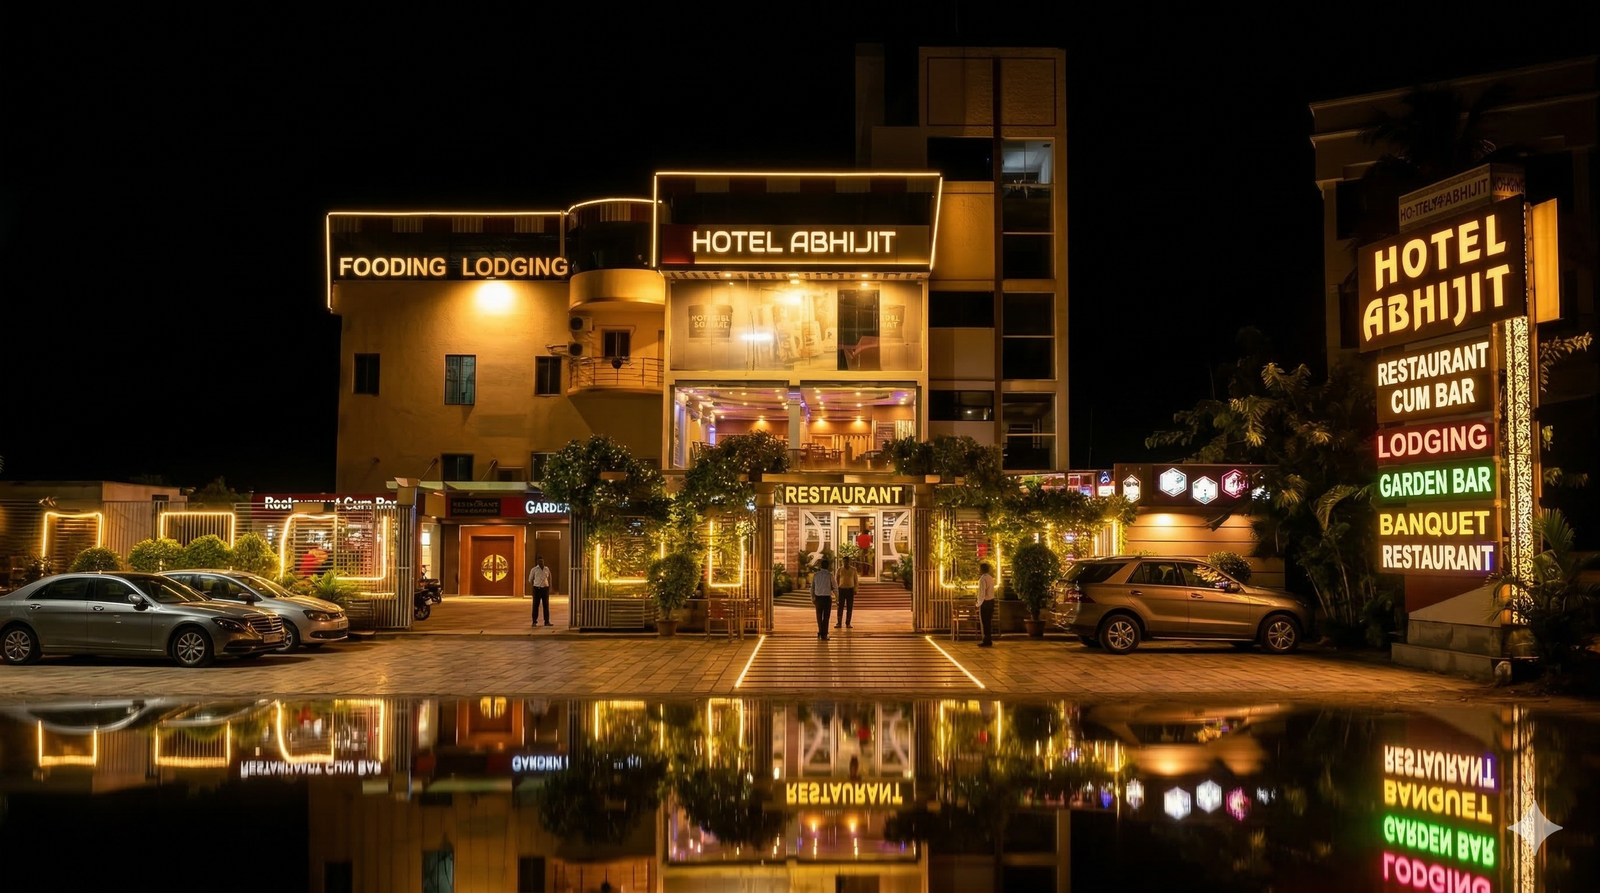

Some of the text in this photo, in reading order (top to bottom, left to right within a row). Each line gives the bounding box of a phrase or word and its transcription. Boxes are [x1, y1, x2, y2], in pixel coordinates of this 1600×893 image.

[692, 231, 897, 253] HOTEL ABHIJIT
[1374, 214, 1506, 292] HOTEL
[339, 257, 568, 276] FOODING LODGING
[1363, 264, 1510, 342] ABHIJIT
[1378, 341, 1489, 386] RESTAURANT
[1391, 378, 1475, 414] CUM BAR
[1378, 423, 1487, 459] LODGING
[785, 485, 904, 505] RESTAURANT
[1379, 467, 1491, 499] GARDEN BAR
[1379, 510, 1490, 537] BANQUET
[1382, 544, 1493, 571] RESTAURANT
